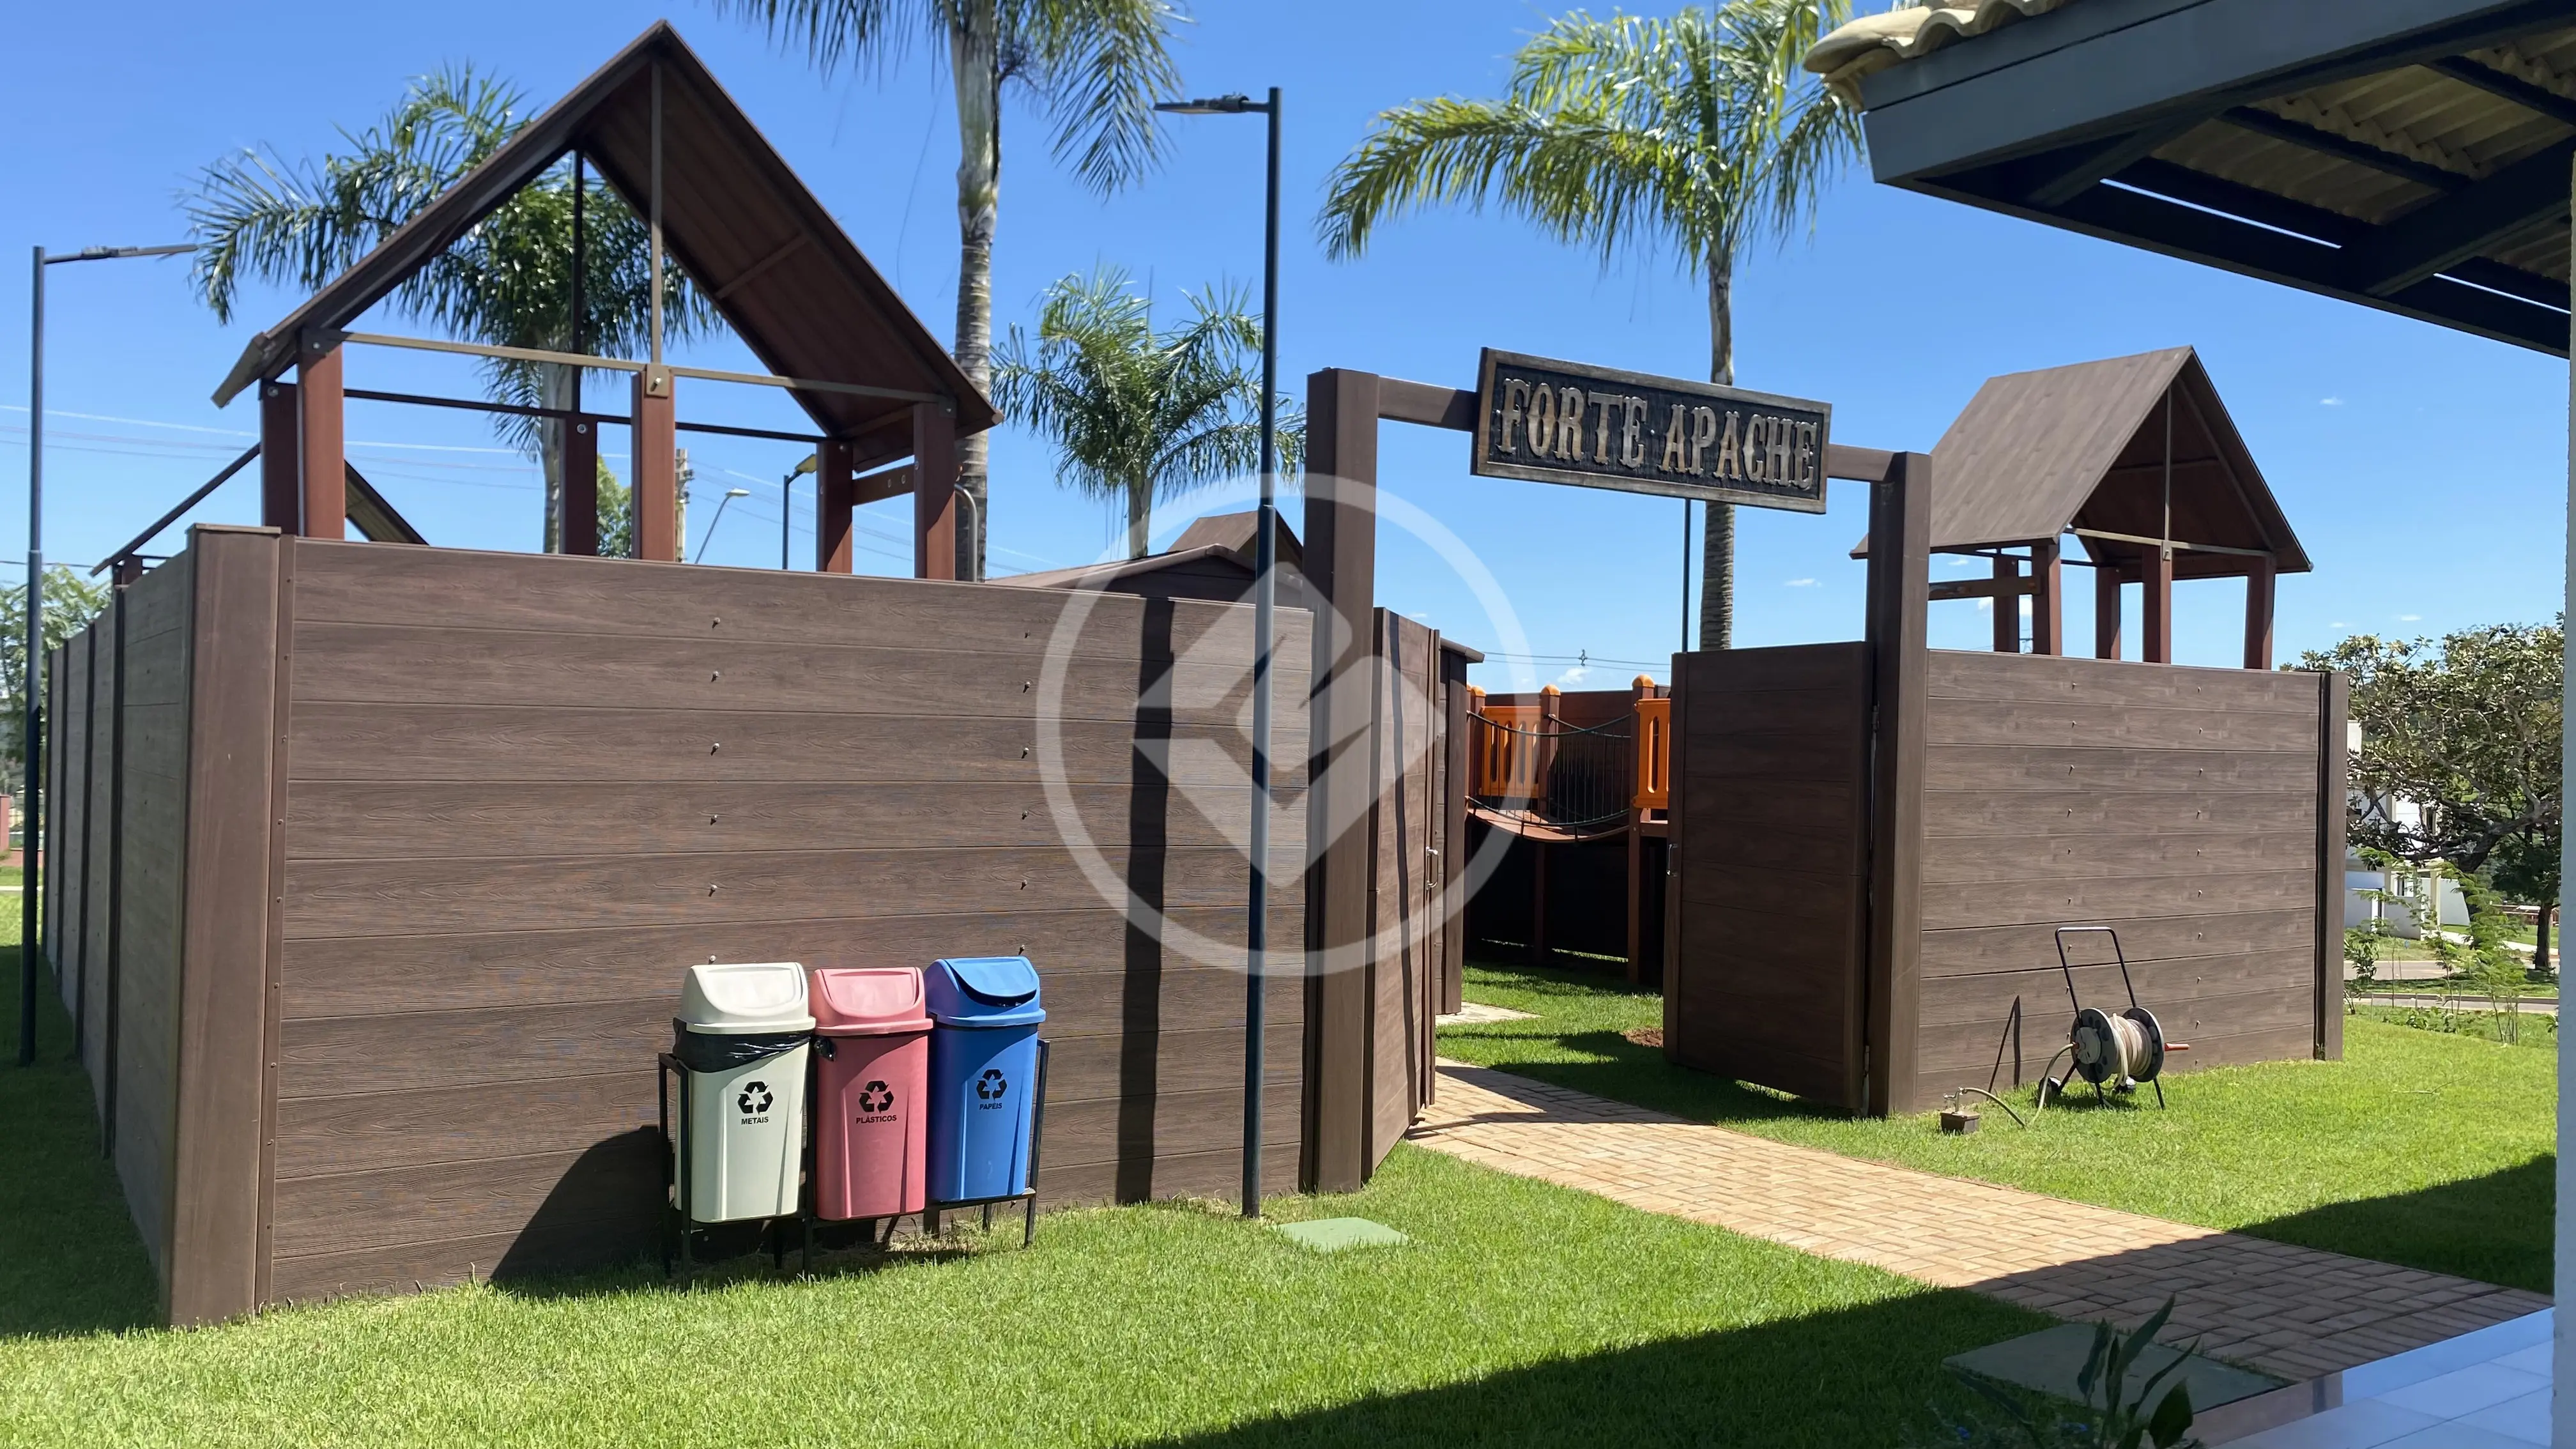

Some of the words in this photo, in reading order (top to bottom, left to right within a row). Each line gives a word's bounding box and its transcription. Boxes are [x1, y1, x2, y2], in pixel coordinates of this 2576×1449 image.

[1495, 378, 1648, 468] FORTE
[1656, 404, 1817, 491] APACHE
[979, 1101, 1002, 1110] PAPÉIS
[741, 1116, 769, 1124] METAIS
[856, 1115, 897, 1124] PLÁSTICOS
